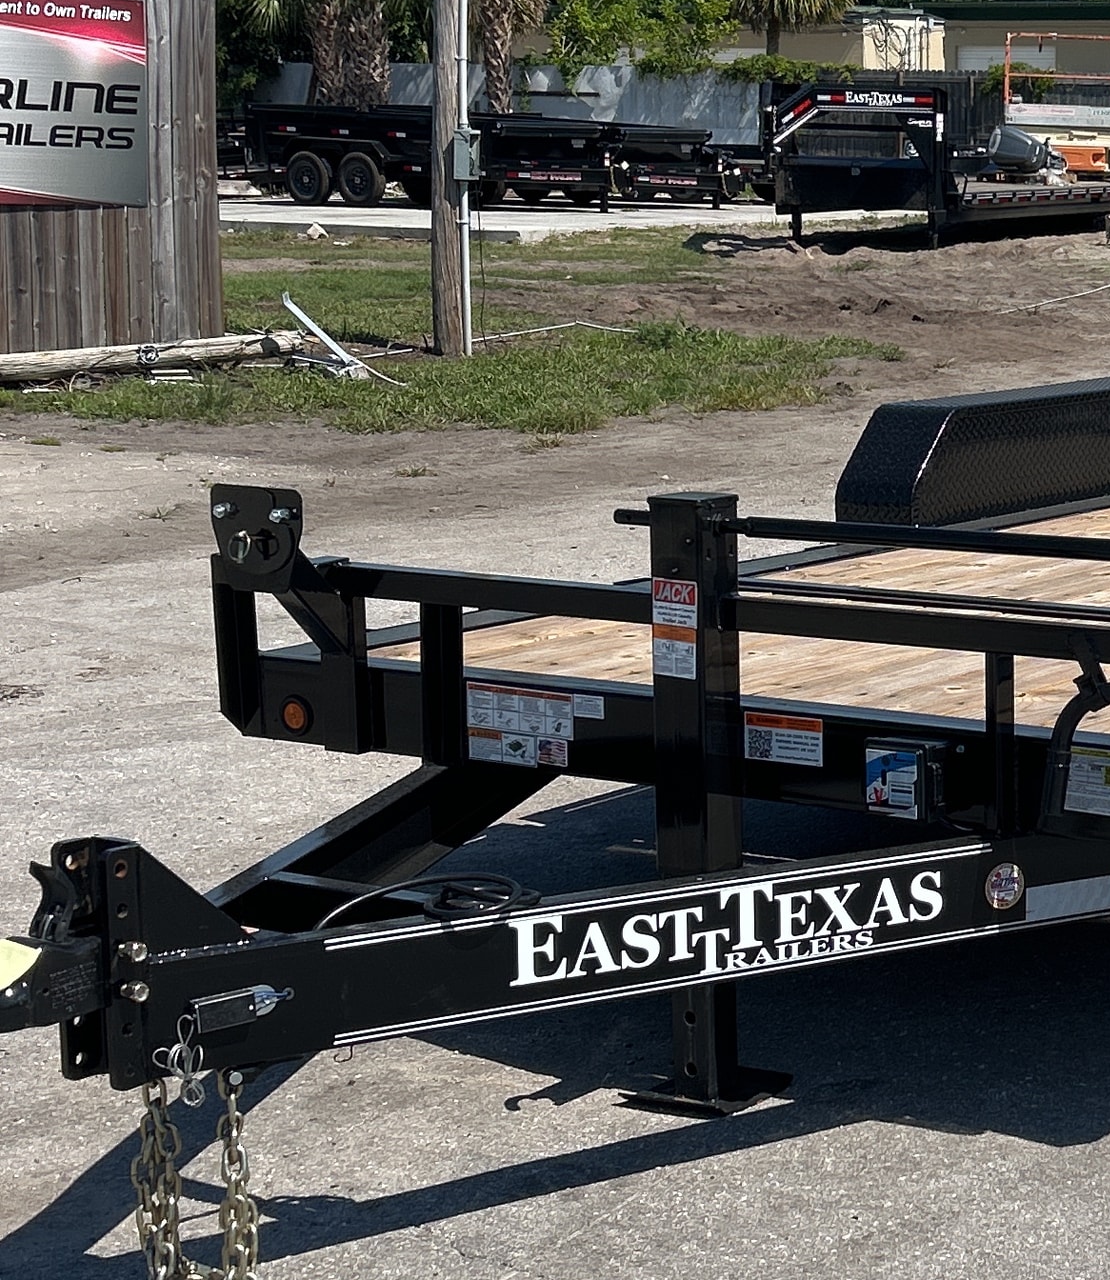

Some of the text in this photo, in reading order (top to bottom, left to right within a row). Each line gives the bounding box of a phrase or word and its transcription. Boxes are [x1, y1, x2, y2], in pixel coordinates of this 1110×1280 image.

[26, 2, 40, 15] to
[44, 2, 75, 17] Own
[80, 5, 131, 21] Trailers
[655, 582, 694, 604] JACK
[508, 906, 703, 987] EAST
[720, 871, 944, 950] TEXAS
[691, 928, 874, 975] TRAILERS
